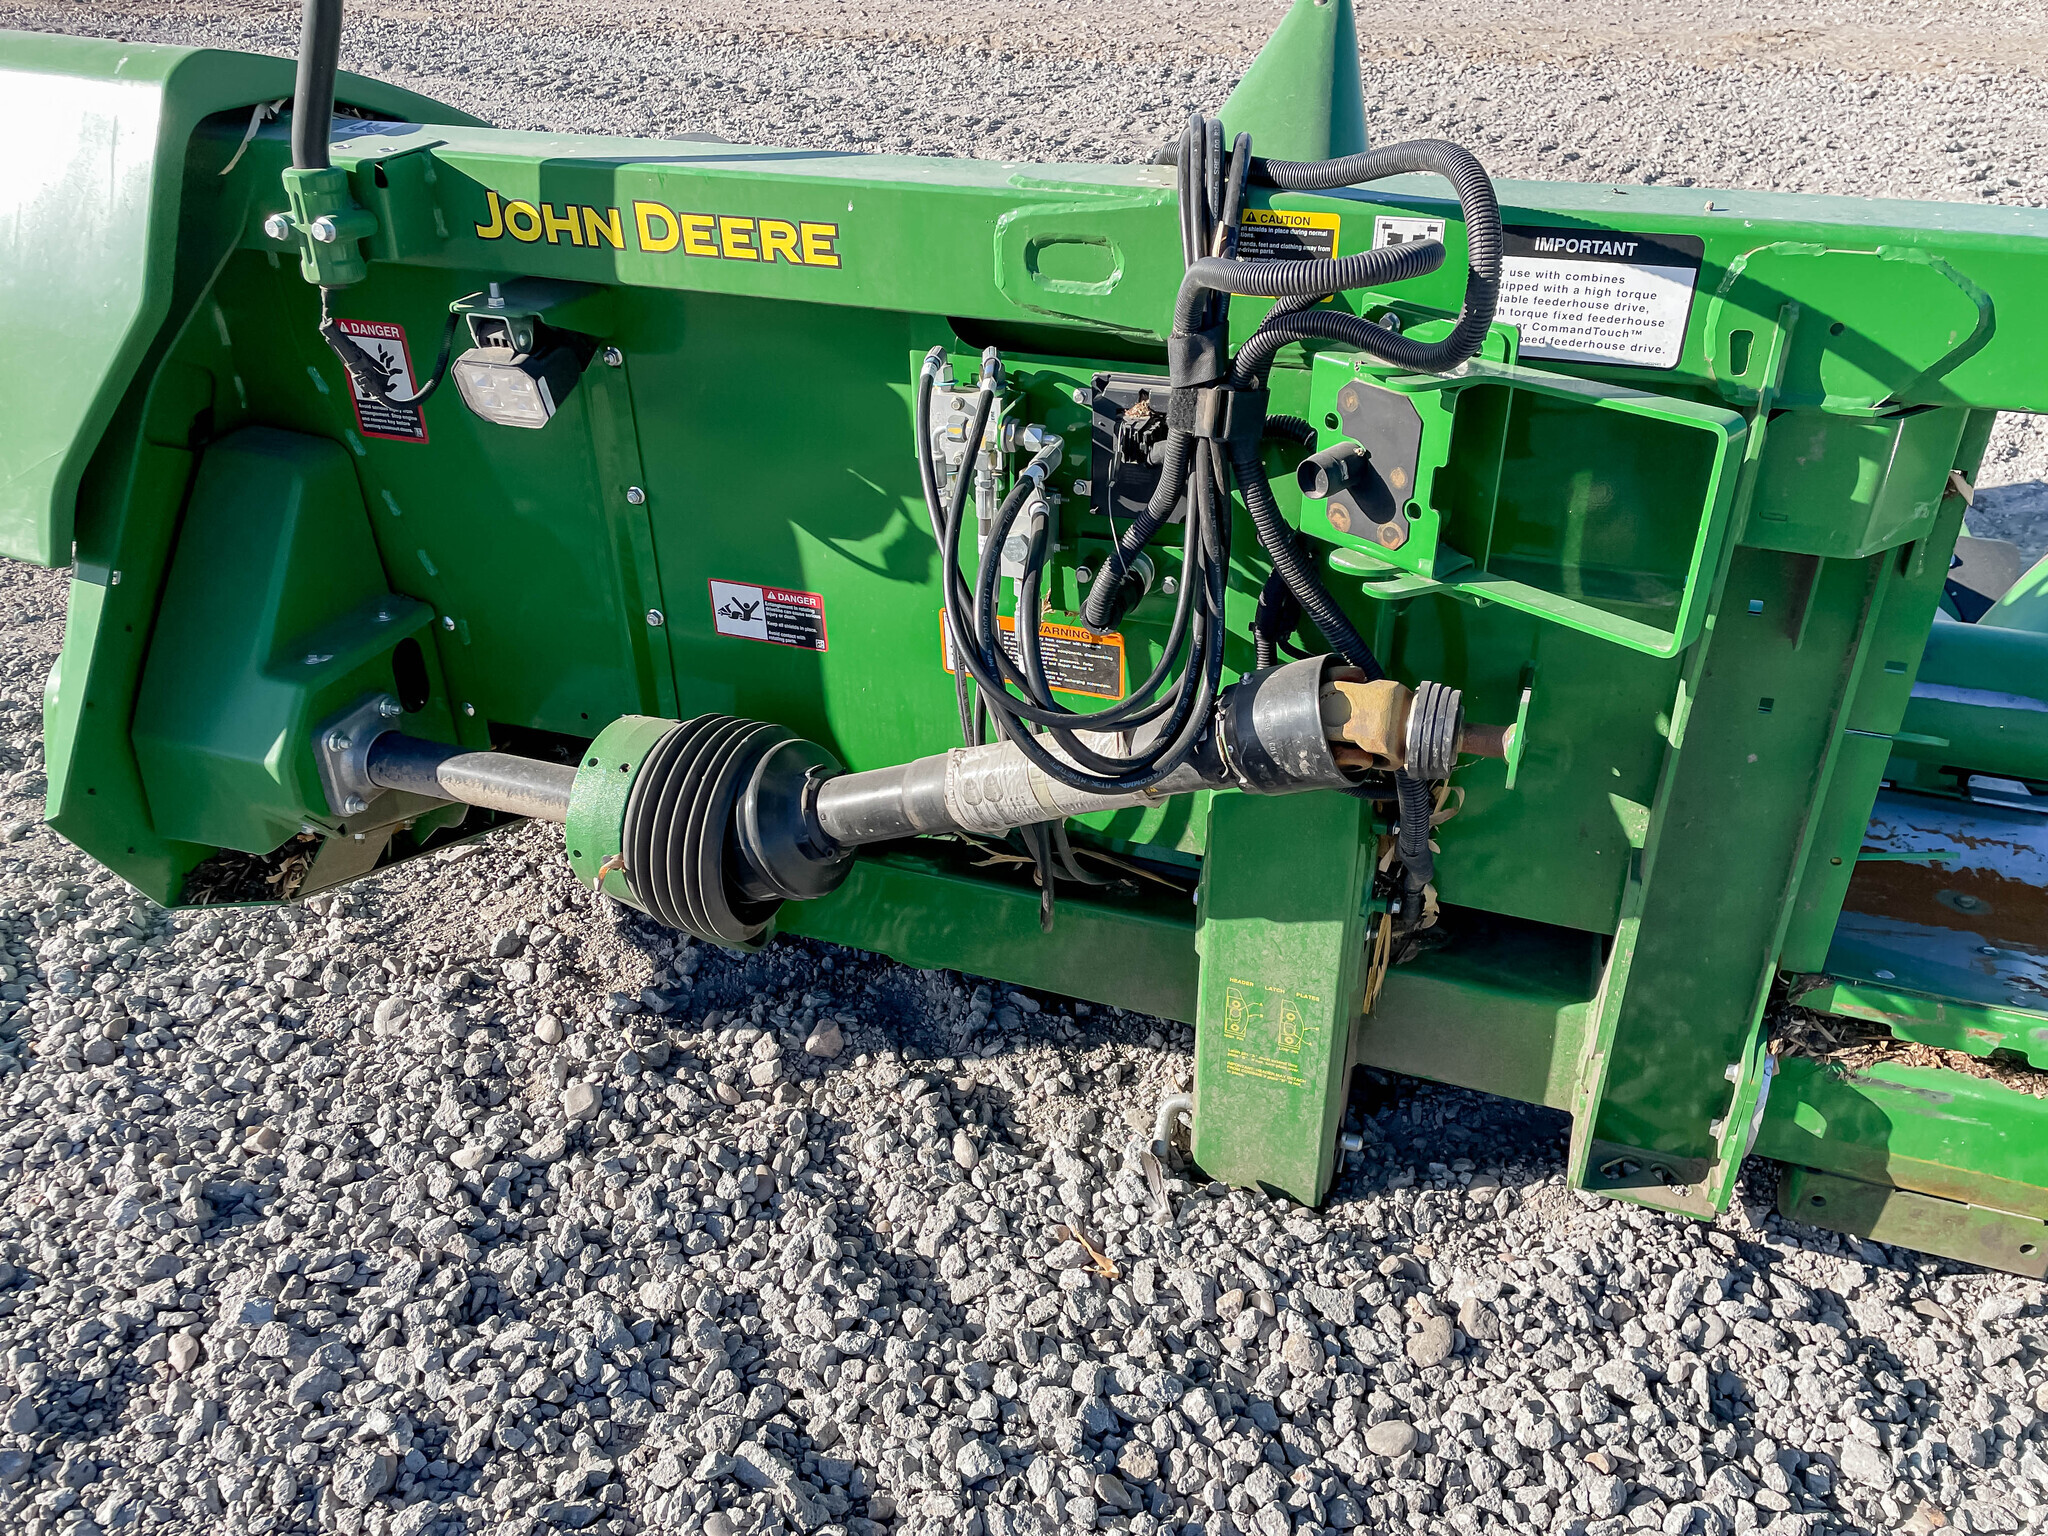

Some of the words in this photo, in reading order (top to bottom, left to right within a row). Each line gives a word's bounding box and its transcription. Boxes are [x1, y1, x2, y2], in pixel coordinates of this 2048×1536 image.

[1260, 214, 1311, 226] CAUTION
[474, 190, 627, 251] JOHN
[632, 200, 842, 269] DEERE
[1280, 243, 1301, 251] clothing
[1535, 237, 1638, 256] IMPORTANT
[1536, 270, 1560, 279] with
[1565, 273, 1625, 284] combines
[1544, 283, 1568, 294] with
[1574, 286, 1580, 295] a
[1585, 286, 1611, 298] high
[1616, 288, 1657, 300] torque
[1534, 297, 1609, 310] feederhouse
[1614, 302, 1649, 315] drive,
[1510, 308, 1548, 319] torque
[1553, 311, 1583, 322] fixed
[1588, 313, 1665, 328] feederhouse
[351, 323, 400, 338] DANGER
[1550, 337, 1625, 351] feederhouse
[1631, 342, 1665, 354] drive.
[778, 593, 816, 606] DANGER
[1229, 978, 1254, 987] HEADER
[1265, 985, 1285, 994] LATCH
